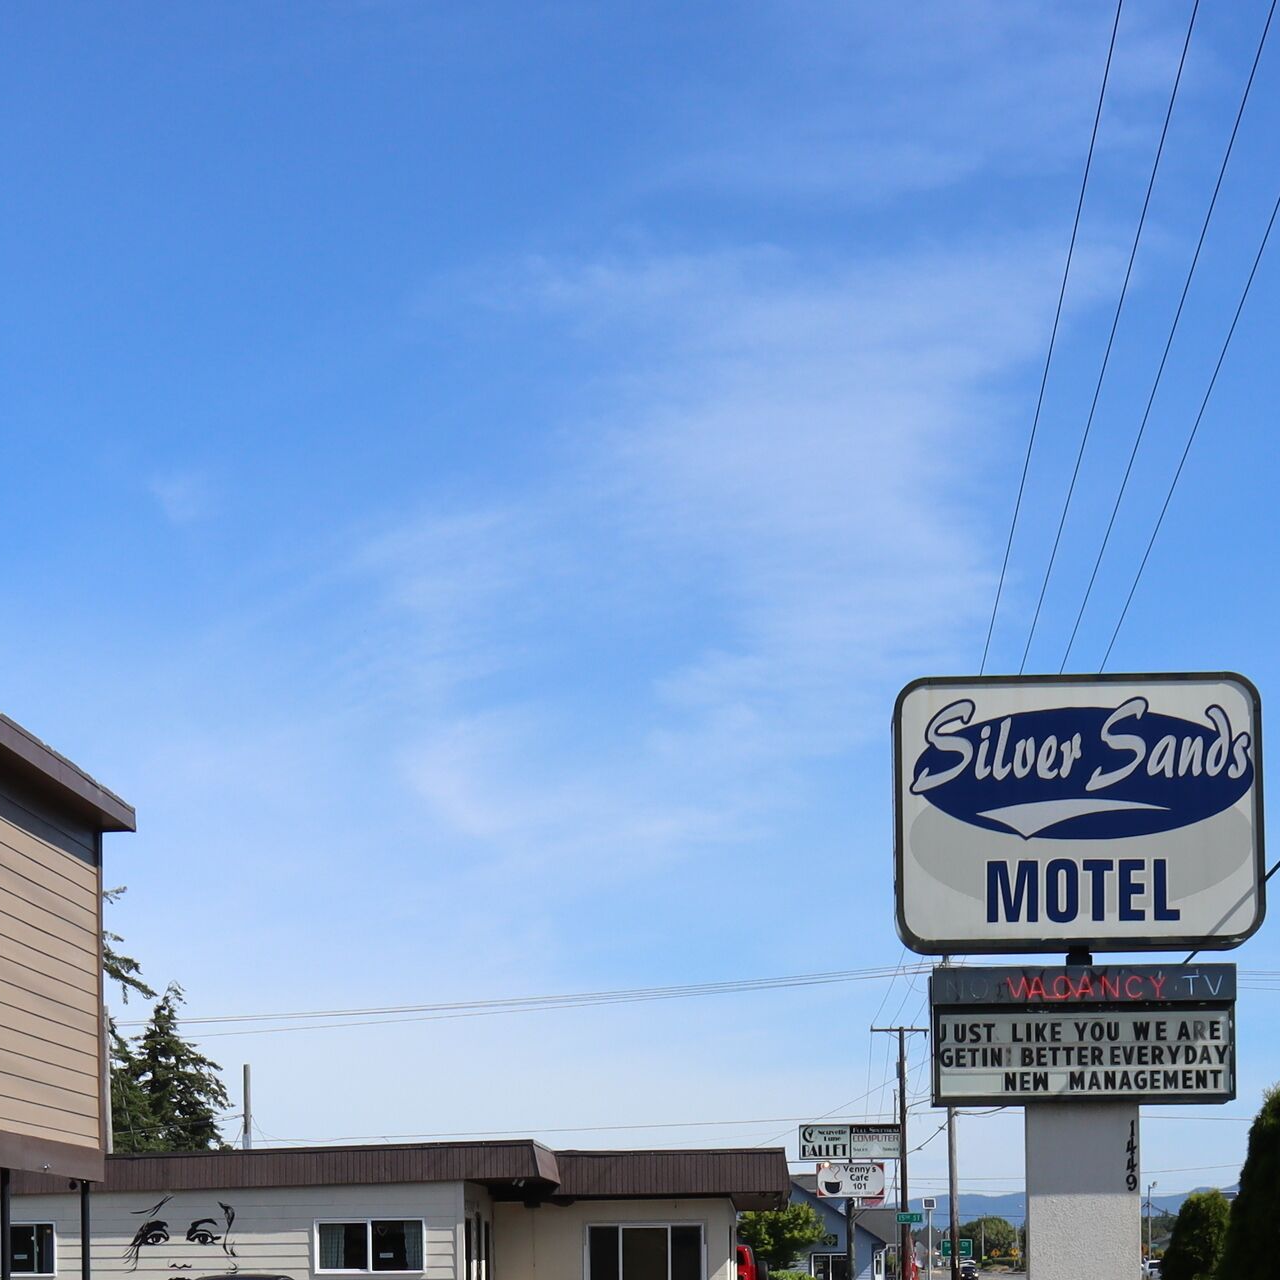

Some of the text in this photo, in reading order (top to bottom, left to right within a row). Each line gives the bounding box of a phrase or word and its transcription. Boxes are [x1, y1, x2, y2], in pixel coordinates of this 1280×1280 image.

[910, 697, 1251, 794] Silver Sands
[986, 858, 1181, 923] MOTEL
[1006, 975, 1167, 999] VACANCY
[1182, 974, 1223, 996] TV
[939, 1020, 1221, 1043] JUST LIKE YOU WE ARE
[1021, 1046, 1104, 1066] BETTER
[1110, 1045, 1229, 1066] EVERYDAY
[1004, 1069, 1222, 1092] NEW MANAGEMENT
[852, 1134, 899, 1143] COMPUTER
[802, 1144, 848, 1157] BALLET
[1126, 1120, 1138, 1192] 1449
